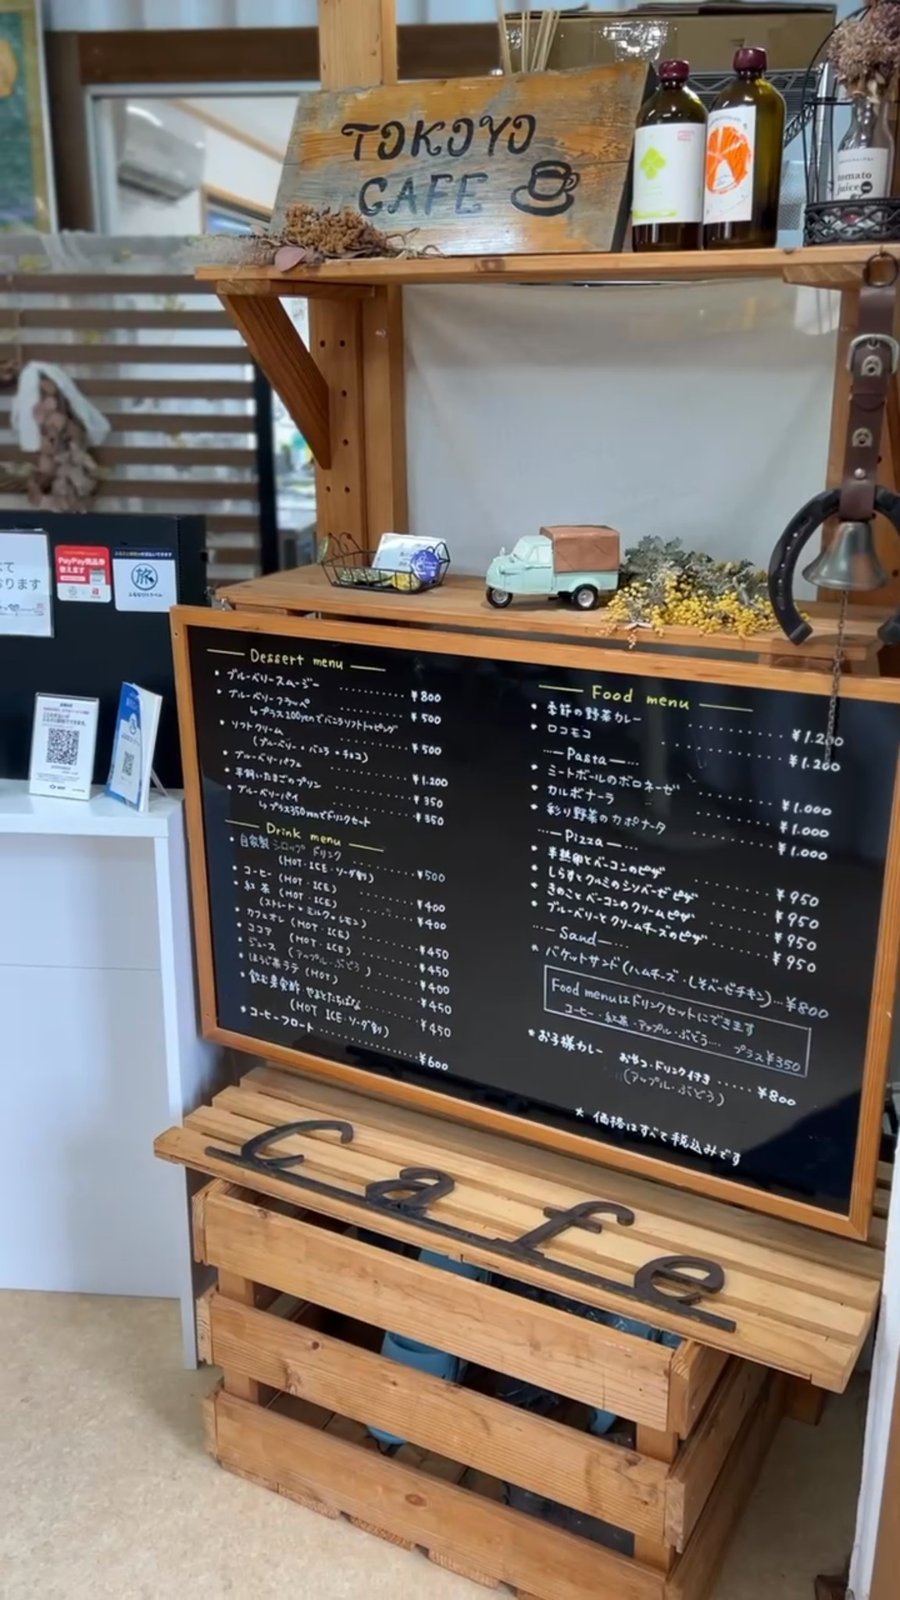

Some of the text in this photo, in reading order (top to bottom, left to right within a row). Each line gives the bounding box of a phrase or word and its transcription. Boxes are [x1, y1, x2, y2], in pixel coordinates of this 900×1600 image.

[341, 114, 536, 161] TOKOYO
[358, 171, 489, 217] CAFE
[0, 578, 41, 590] ります
[250, 648, 344, 671] Dessert menu
[411, 689, 442, 703] ¥800
[592, 684, 690, 711] Food menu
[411, 711, 442, 725] ¥500
[546, 701, 642, 724] 季節の野菜カレー
[547, 723, 592, 740] ロコモコ
[411, 742, 442, 756] ¥500
[566, 746, 607, 765] Pasta
[414, 794, 444, 809] ¥350
[547, 784, 614, 806] カルボナーラ
[416, 812, 445, 827] ¥350
[265, 822, 342, 847] Drink menu
[565, 828, 604, 848] Pizza
[417, 870, 446, 883] ¥500
[244, 865, 272, 878] コーヒー
[417, 899, 446, 913] ¥400
[776, 887, 820, 908] ¥950
[417, 916, 447, 930] ¥400
[774, 909, 820, 930] ¥950
[559, 925, 598, 947] Sand
[773, 931, 818, 952] ¥950
[247, 922, 273, 937] ココア
[419, 962, 450, 978] ¥450
[419, 944, 450, 960] ¥450
[772, 950, 817, 973] ¥950
[420, 979, 450, 995] ¥400
[551, 977, 580, 997] Food
[421, 997, 452, 1015] ¥450
[785, 996, 830, 1020] ¥800
[249, 1006, 449, 1071] コーヒーフロート ¥600
[421, 1018, 452, 1038] ¥450
[537, 1028, 603, 1054] お子様カレー
[757, 1085, 797, 1107] ¥800
